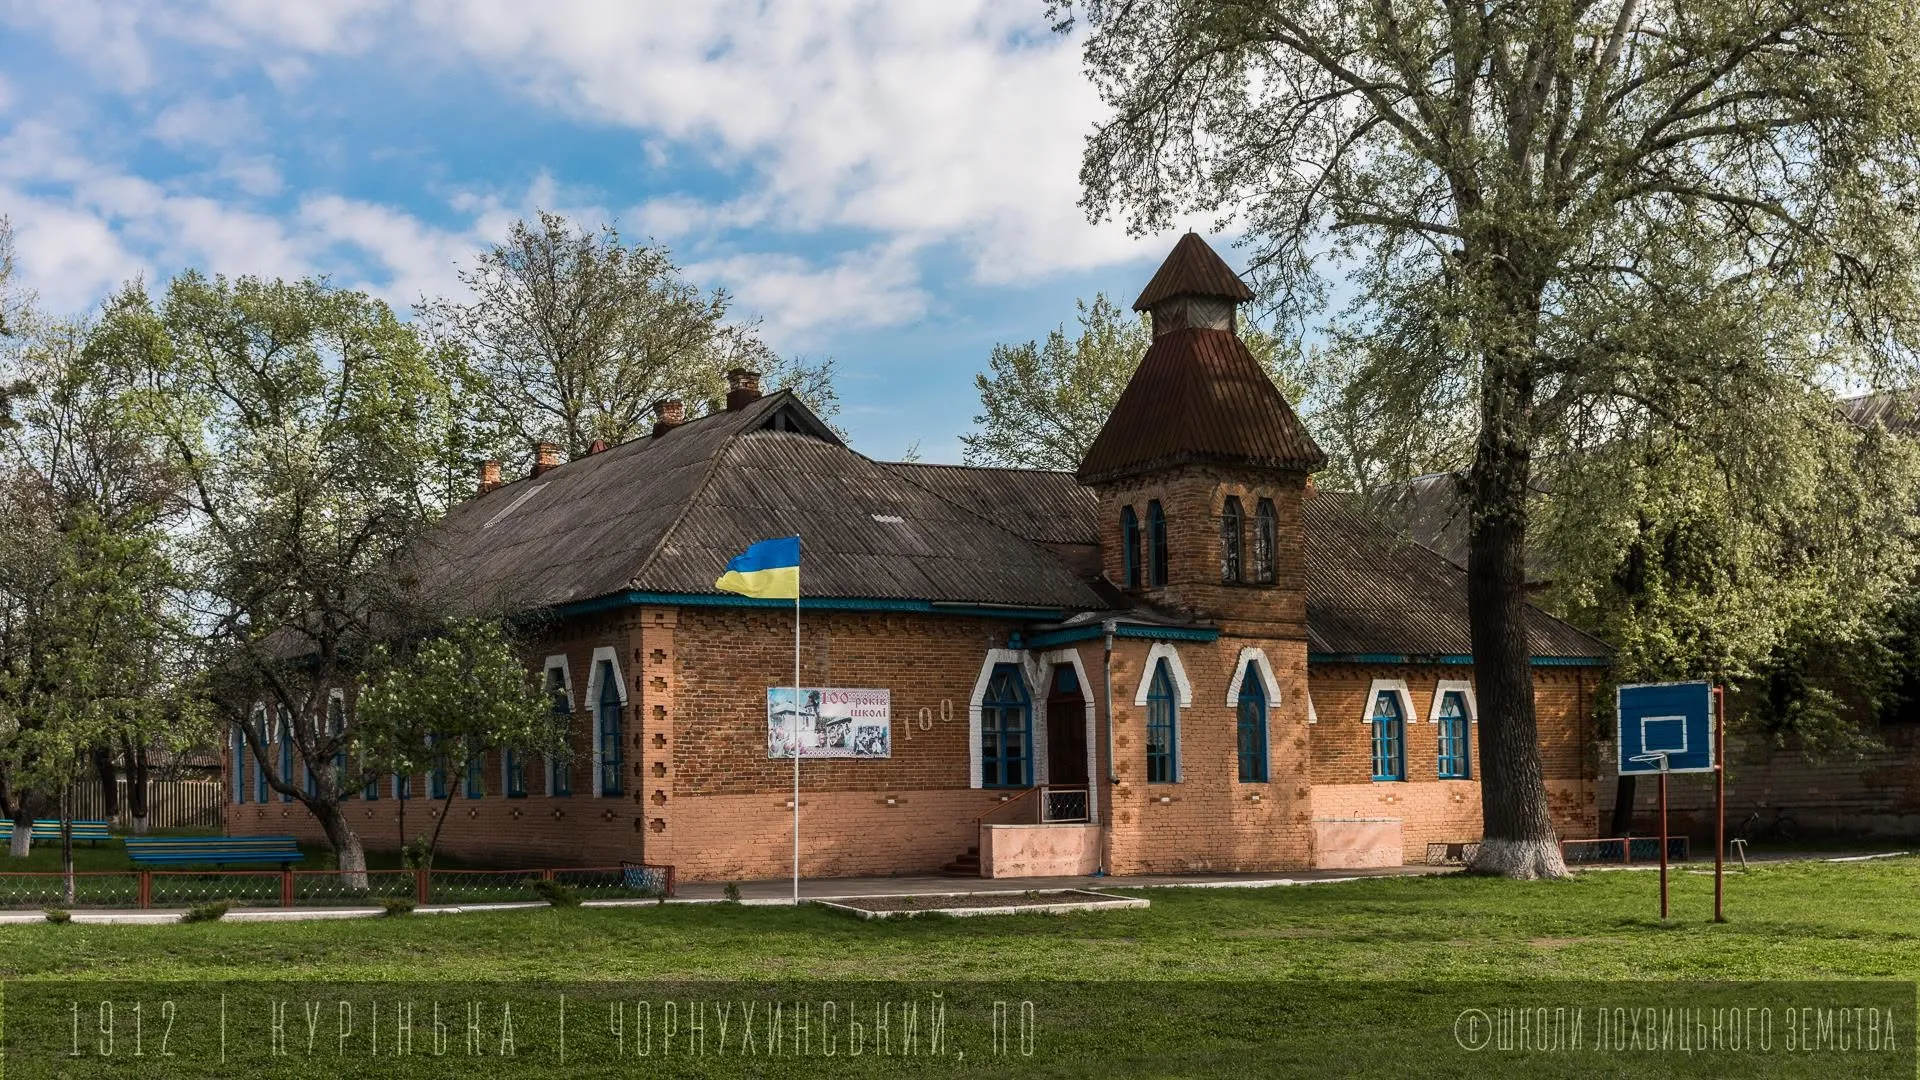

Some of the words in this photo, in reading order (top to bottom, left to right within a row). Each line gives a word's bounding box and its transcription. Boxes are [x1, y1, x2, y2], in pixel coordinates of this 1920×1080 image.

[820, 691, 849, 705] 100
[855, 695, 887, 707] років
[850, 707, 887, 717] школі
